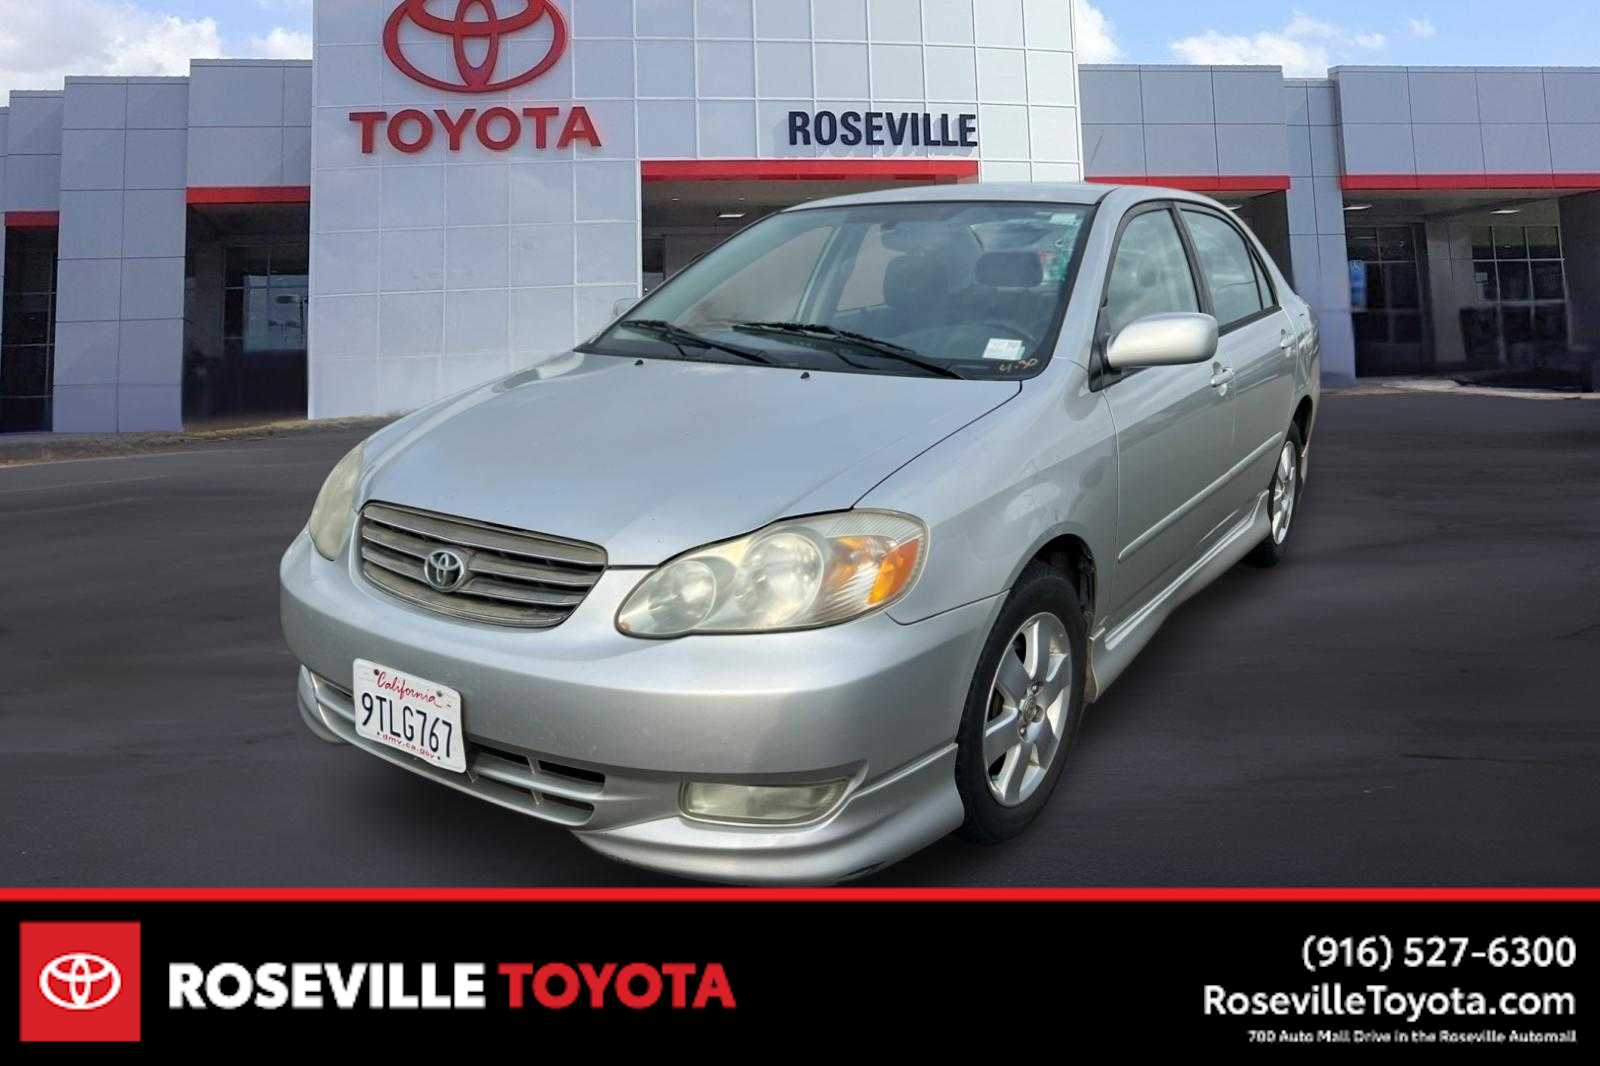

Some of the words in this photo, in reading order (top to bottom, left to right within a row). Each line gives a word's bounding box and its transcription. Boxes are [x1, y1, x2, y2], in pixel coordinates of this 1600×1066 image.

[350, 106, 602, 154] TOYOTA
[788, 111, 978, 147] ROSEVILLE
[376, 671, 441, 708] California
[361, 692, 452, 758] 9TLG767
[382, 733, 434, 758] dmv.ca.gov
